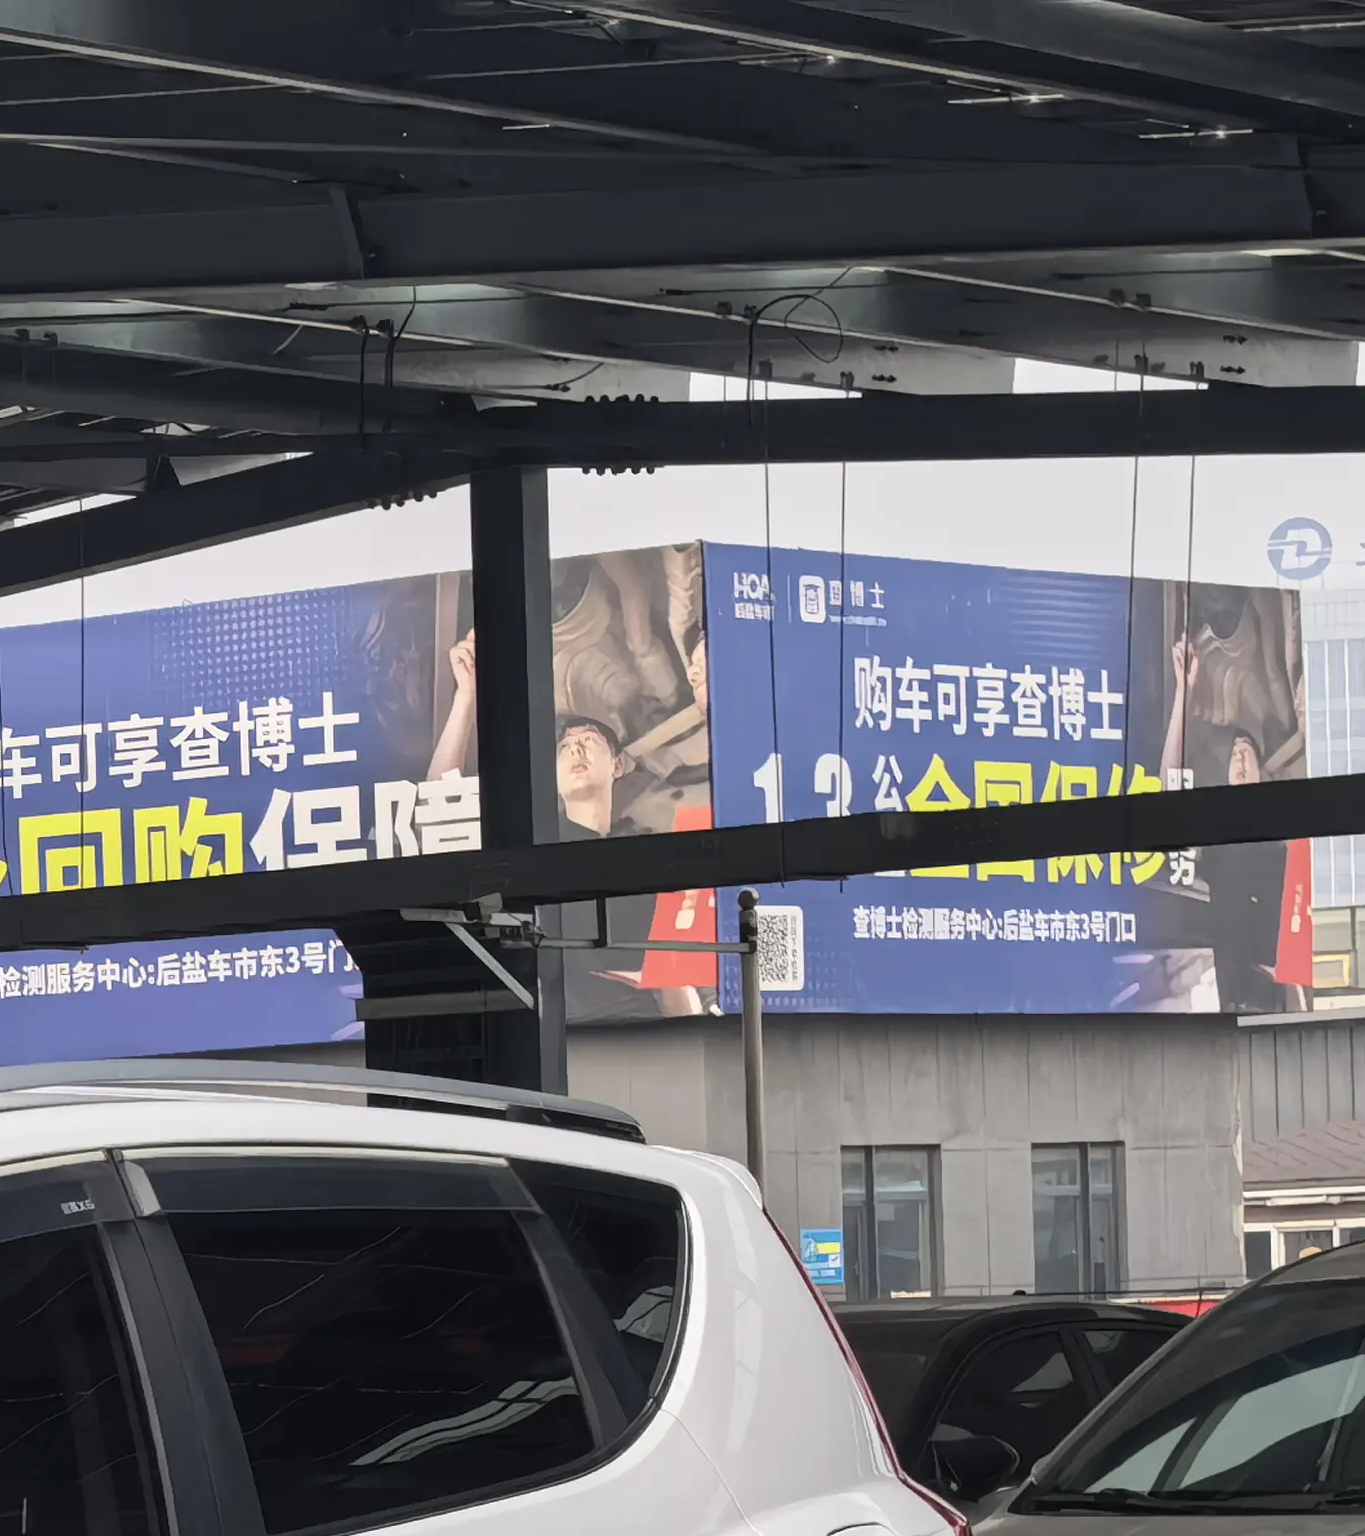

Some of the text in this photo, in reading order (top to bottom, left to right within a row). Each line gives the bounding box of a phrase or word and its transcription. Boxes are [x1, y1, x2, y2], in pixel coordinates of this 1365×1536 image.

[854, 655, 1126, 742] 购车可享查博士
